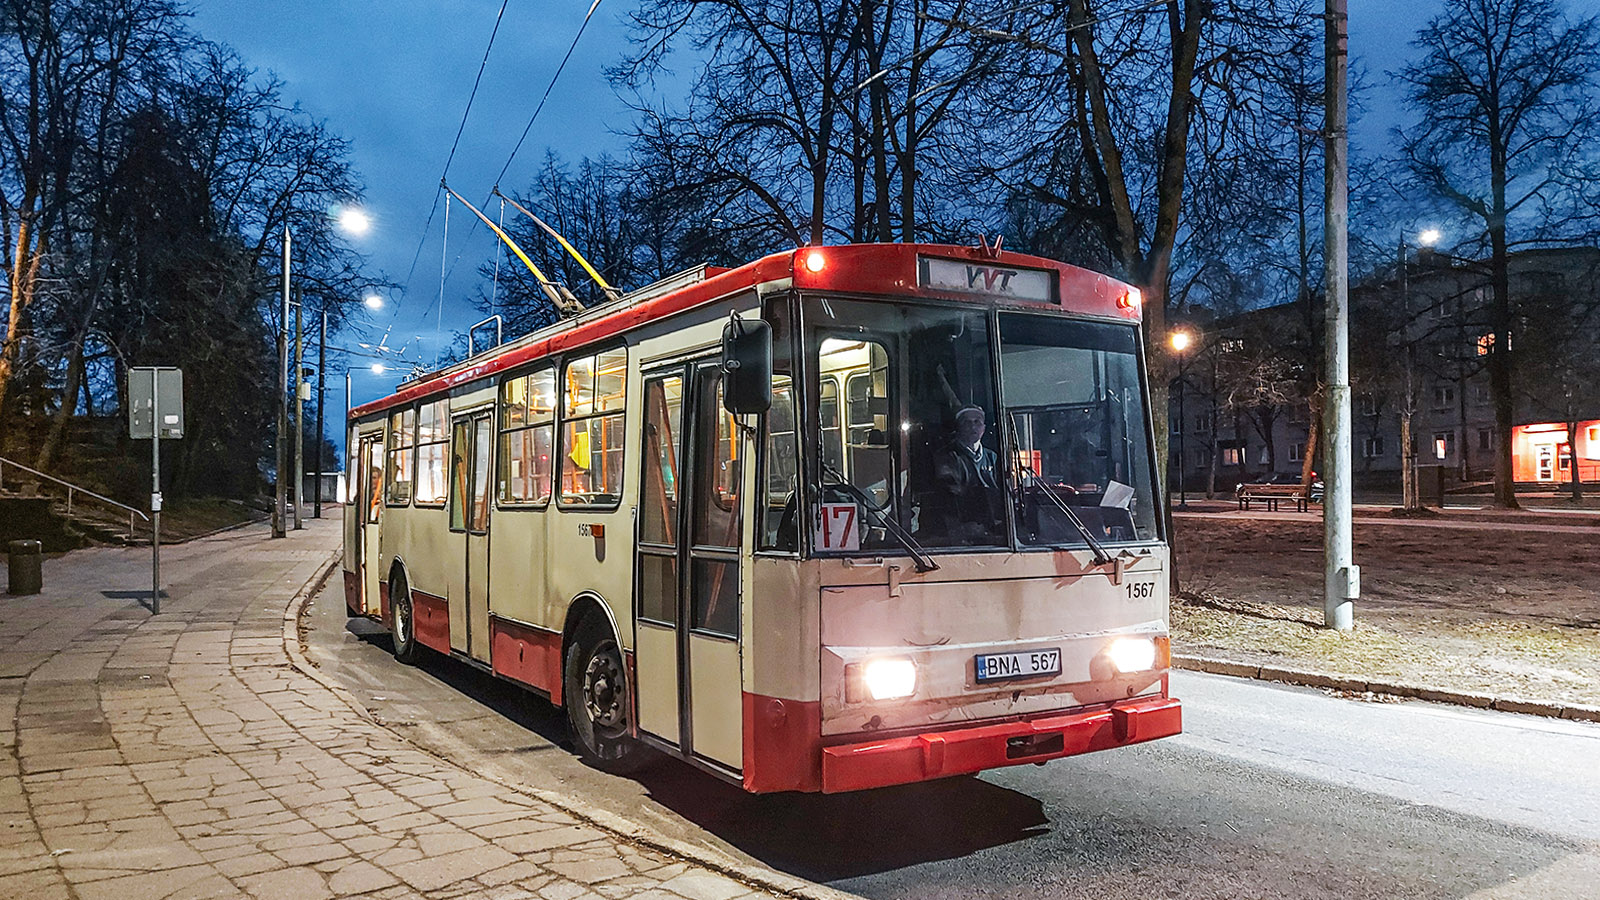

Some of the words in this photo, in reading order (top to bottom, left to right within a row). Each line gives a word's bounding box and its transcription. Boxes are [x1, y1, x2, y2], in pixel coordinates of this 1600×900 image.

[818, 506, 856, 548] 17
[1125, 582, 1155, 599] 1567
[987, 655, 1021, 676] BNA
[1030, 652, 1057, 671] 567
